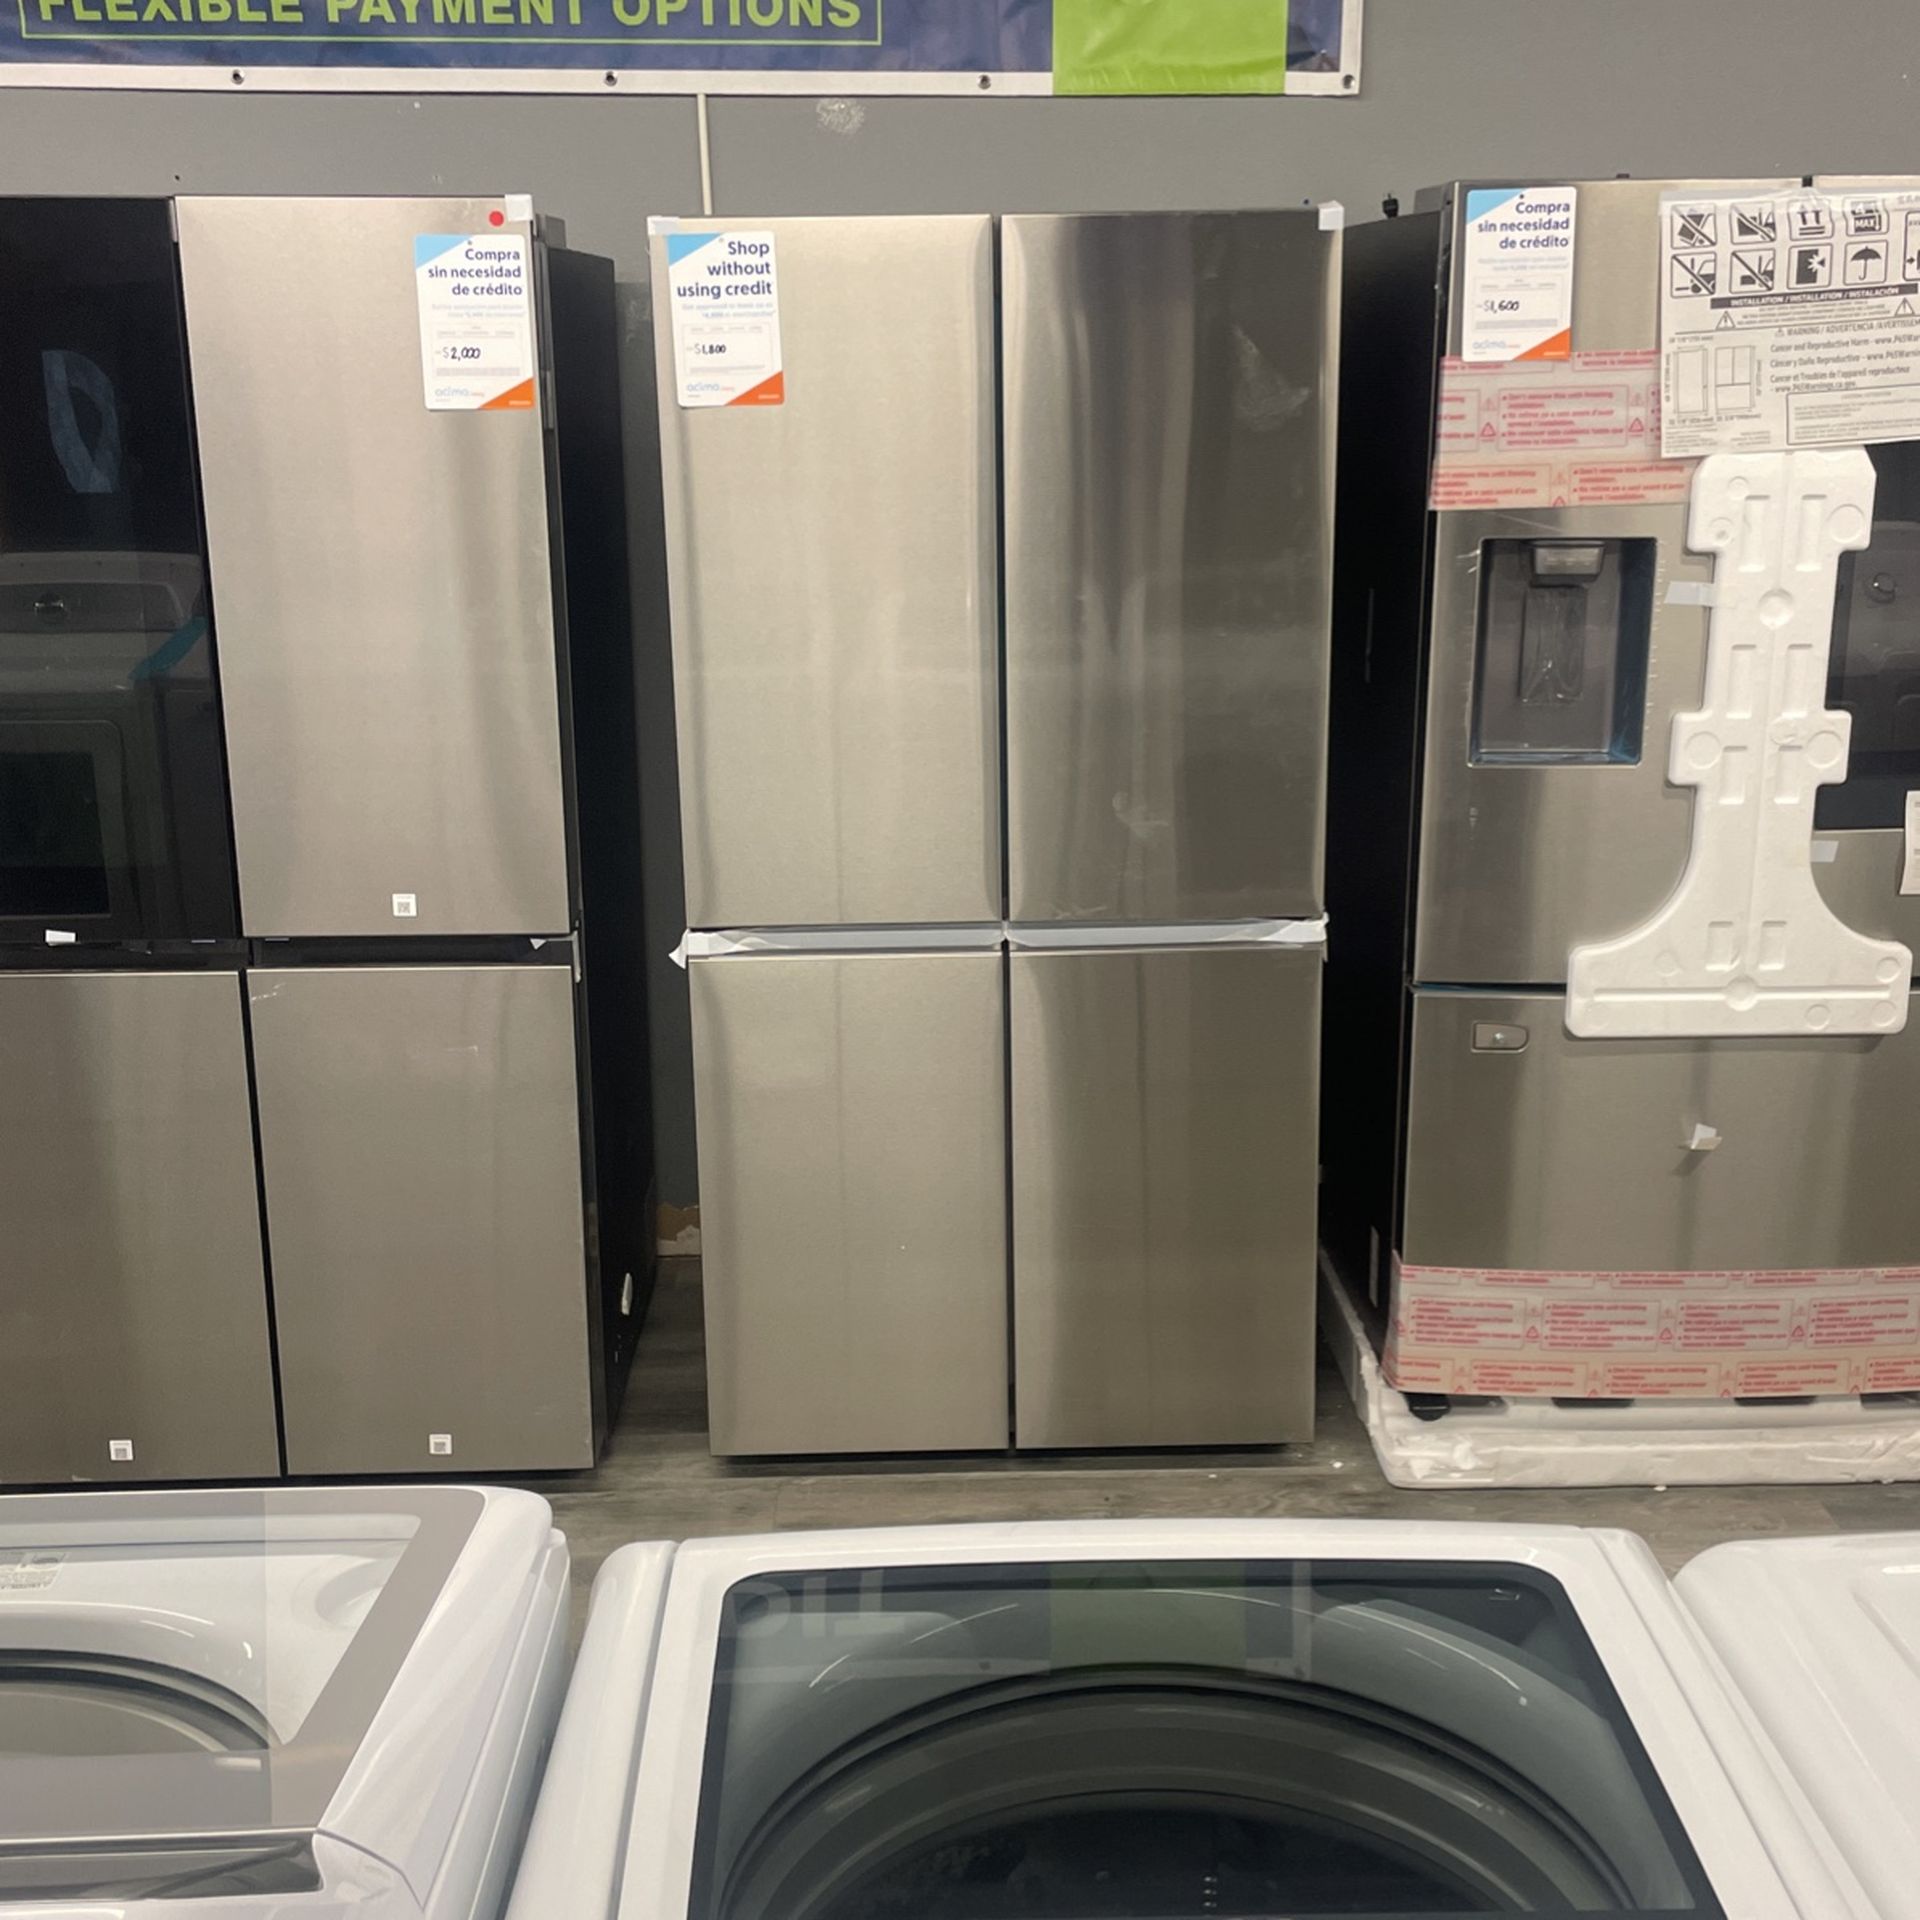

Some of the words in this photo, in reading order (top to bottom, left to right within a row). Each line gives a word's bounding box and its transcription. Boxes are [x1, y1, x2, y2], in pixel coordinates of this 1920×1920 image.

[612, 0, 861, 27] OPTIONS
[1516, 202, 1570, 217] Compra
[1478, 221, 1497, 233] sin
[1500, 219, 1570, 232] necesidad
[727, 240, 770, 258] Shop
[1499, 237, 1517, 249] de
[1520, 235, 1569, 249] crédito
[465, 248, 521, 265] Compra
[428, 266, 447, 278] sin
[451, 265, 522, 278] necesidad
[707, 261, 771, 276] without
[452, 284, 470, 296] de
[474, 282, 523, 296] crédito
[677, 282, 722, 299] using
[725, 281, 772, 296] credit
